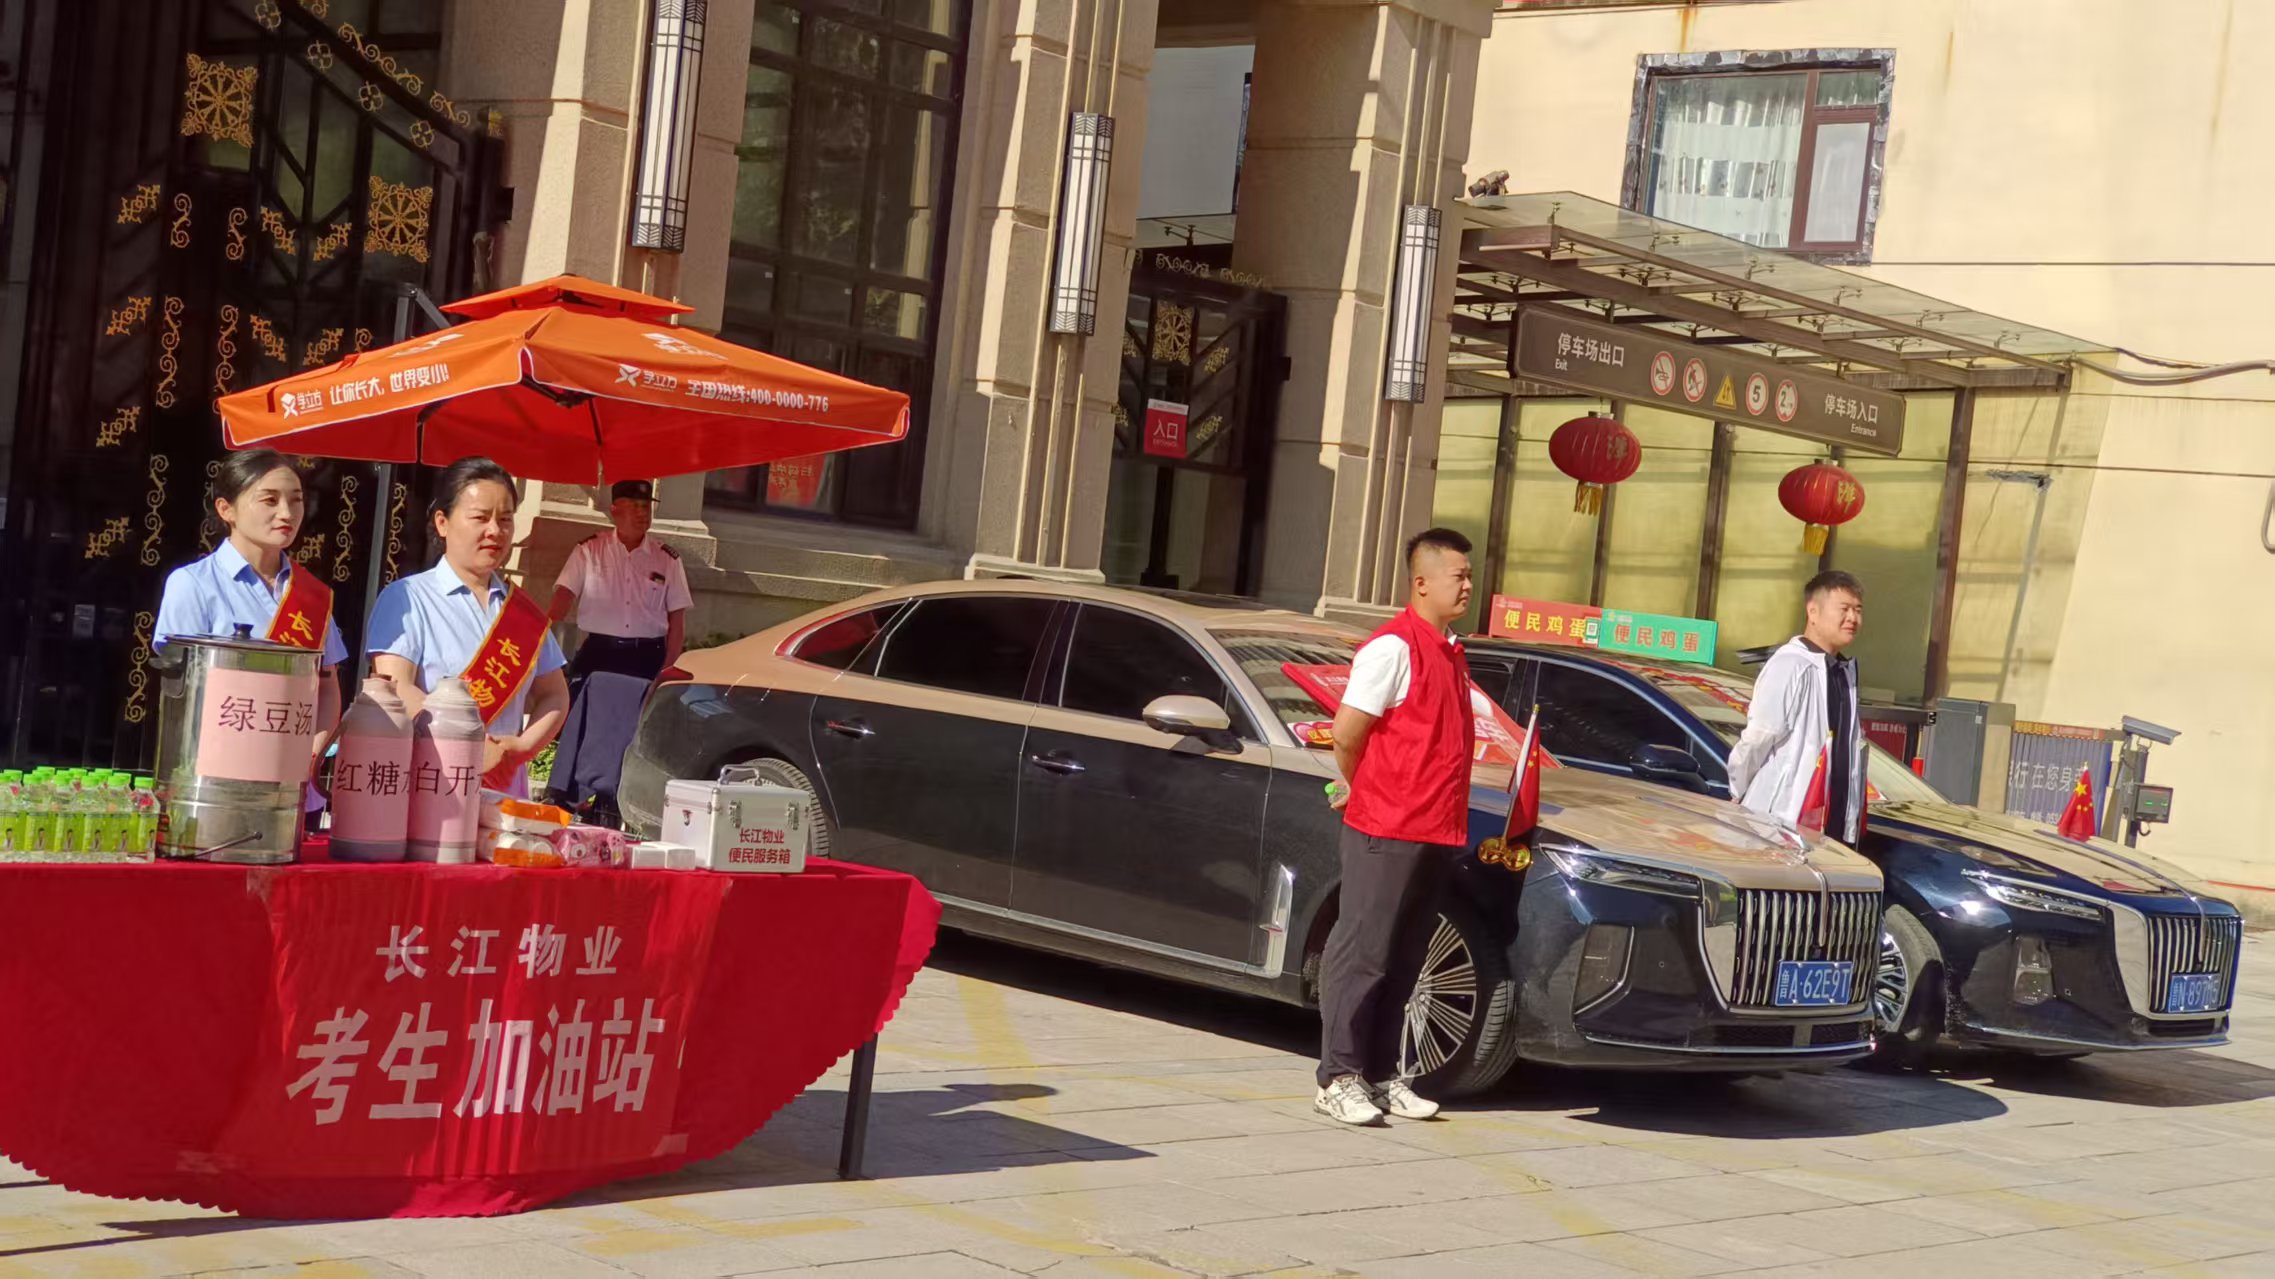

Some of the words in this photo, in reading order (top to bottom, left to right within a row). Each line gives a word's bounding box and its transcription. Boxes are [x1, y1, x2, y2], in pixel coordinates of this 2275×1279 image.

[1558, 332, 1625, 367] 停车场出口
[1752, 384, 1761, 403] 5
[1824, 393, 1878, 424] 停车场入口
[1153, 419, 1178, 440] 入口
[1504, 609, 1586, 638] 便民鸡蛋
[1615, 624, 1699, 653] 便民鸡蛋
[218, 695, 313, 736] 绿豆汤
[739, 827, 785, 844] 长江物业
[728, 847, 791, 865] 便民服务箱
[375, 923, 622, 983] 长江物业
[286, 998, 666, 1126] 考生加油站
